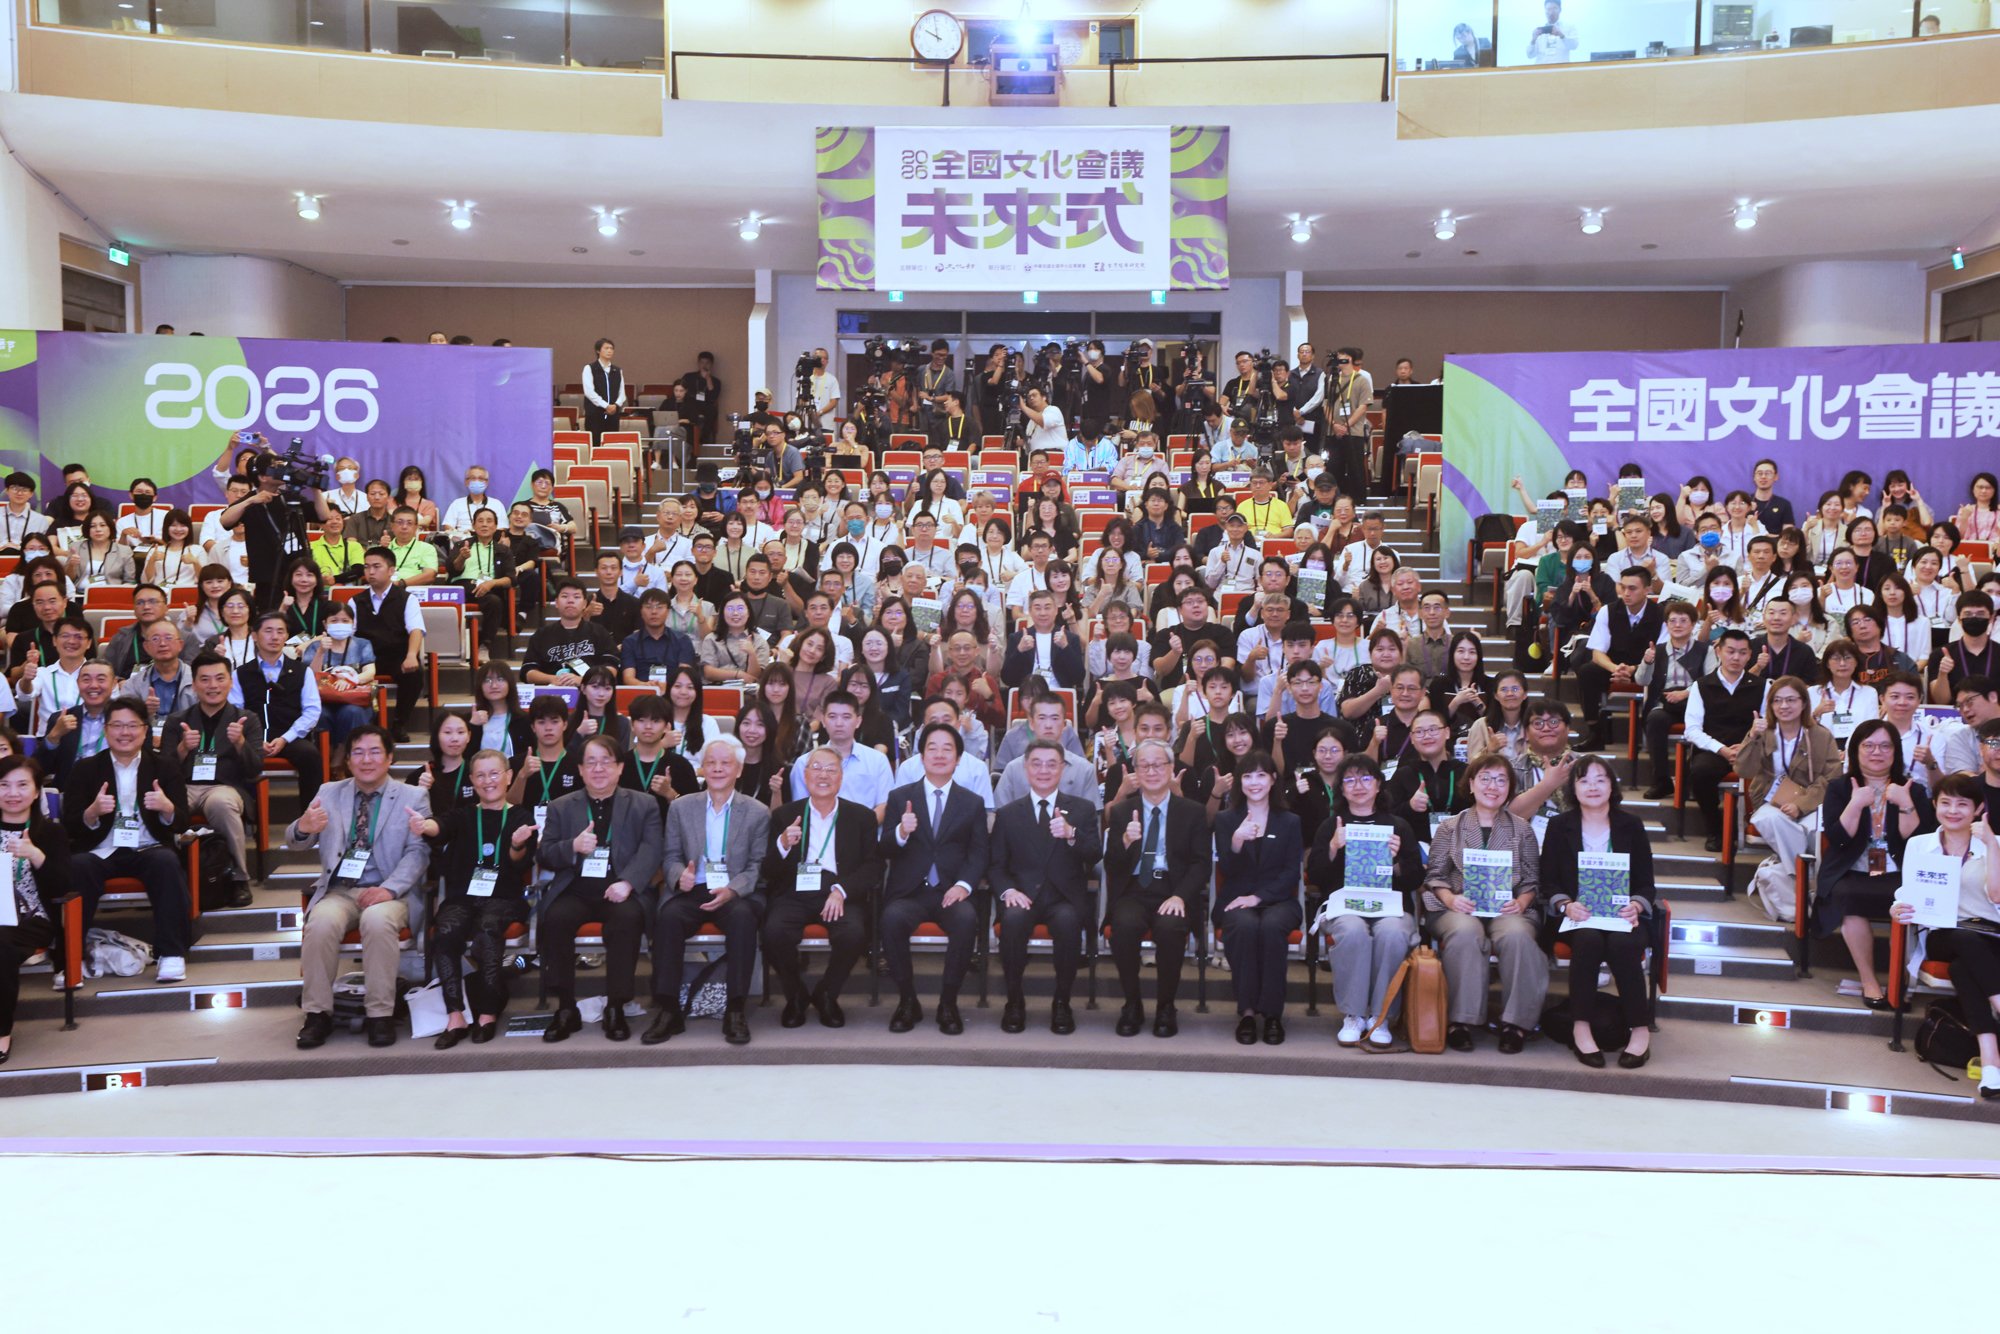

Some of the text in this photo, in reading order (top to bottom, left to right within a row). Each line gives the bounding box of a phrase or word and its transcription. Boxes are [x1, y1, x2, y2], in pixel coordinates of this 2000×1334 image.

[931, 149, 1145, 180] 全國文化會議
[901, 182, 1144, 255] 未來式
[144, 362, 379, 433] 2026
[1568, 371, 2000, 442] 全國文化會議
